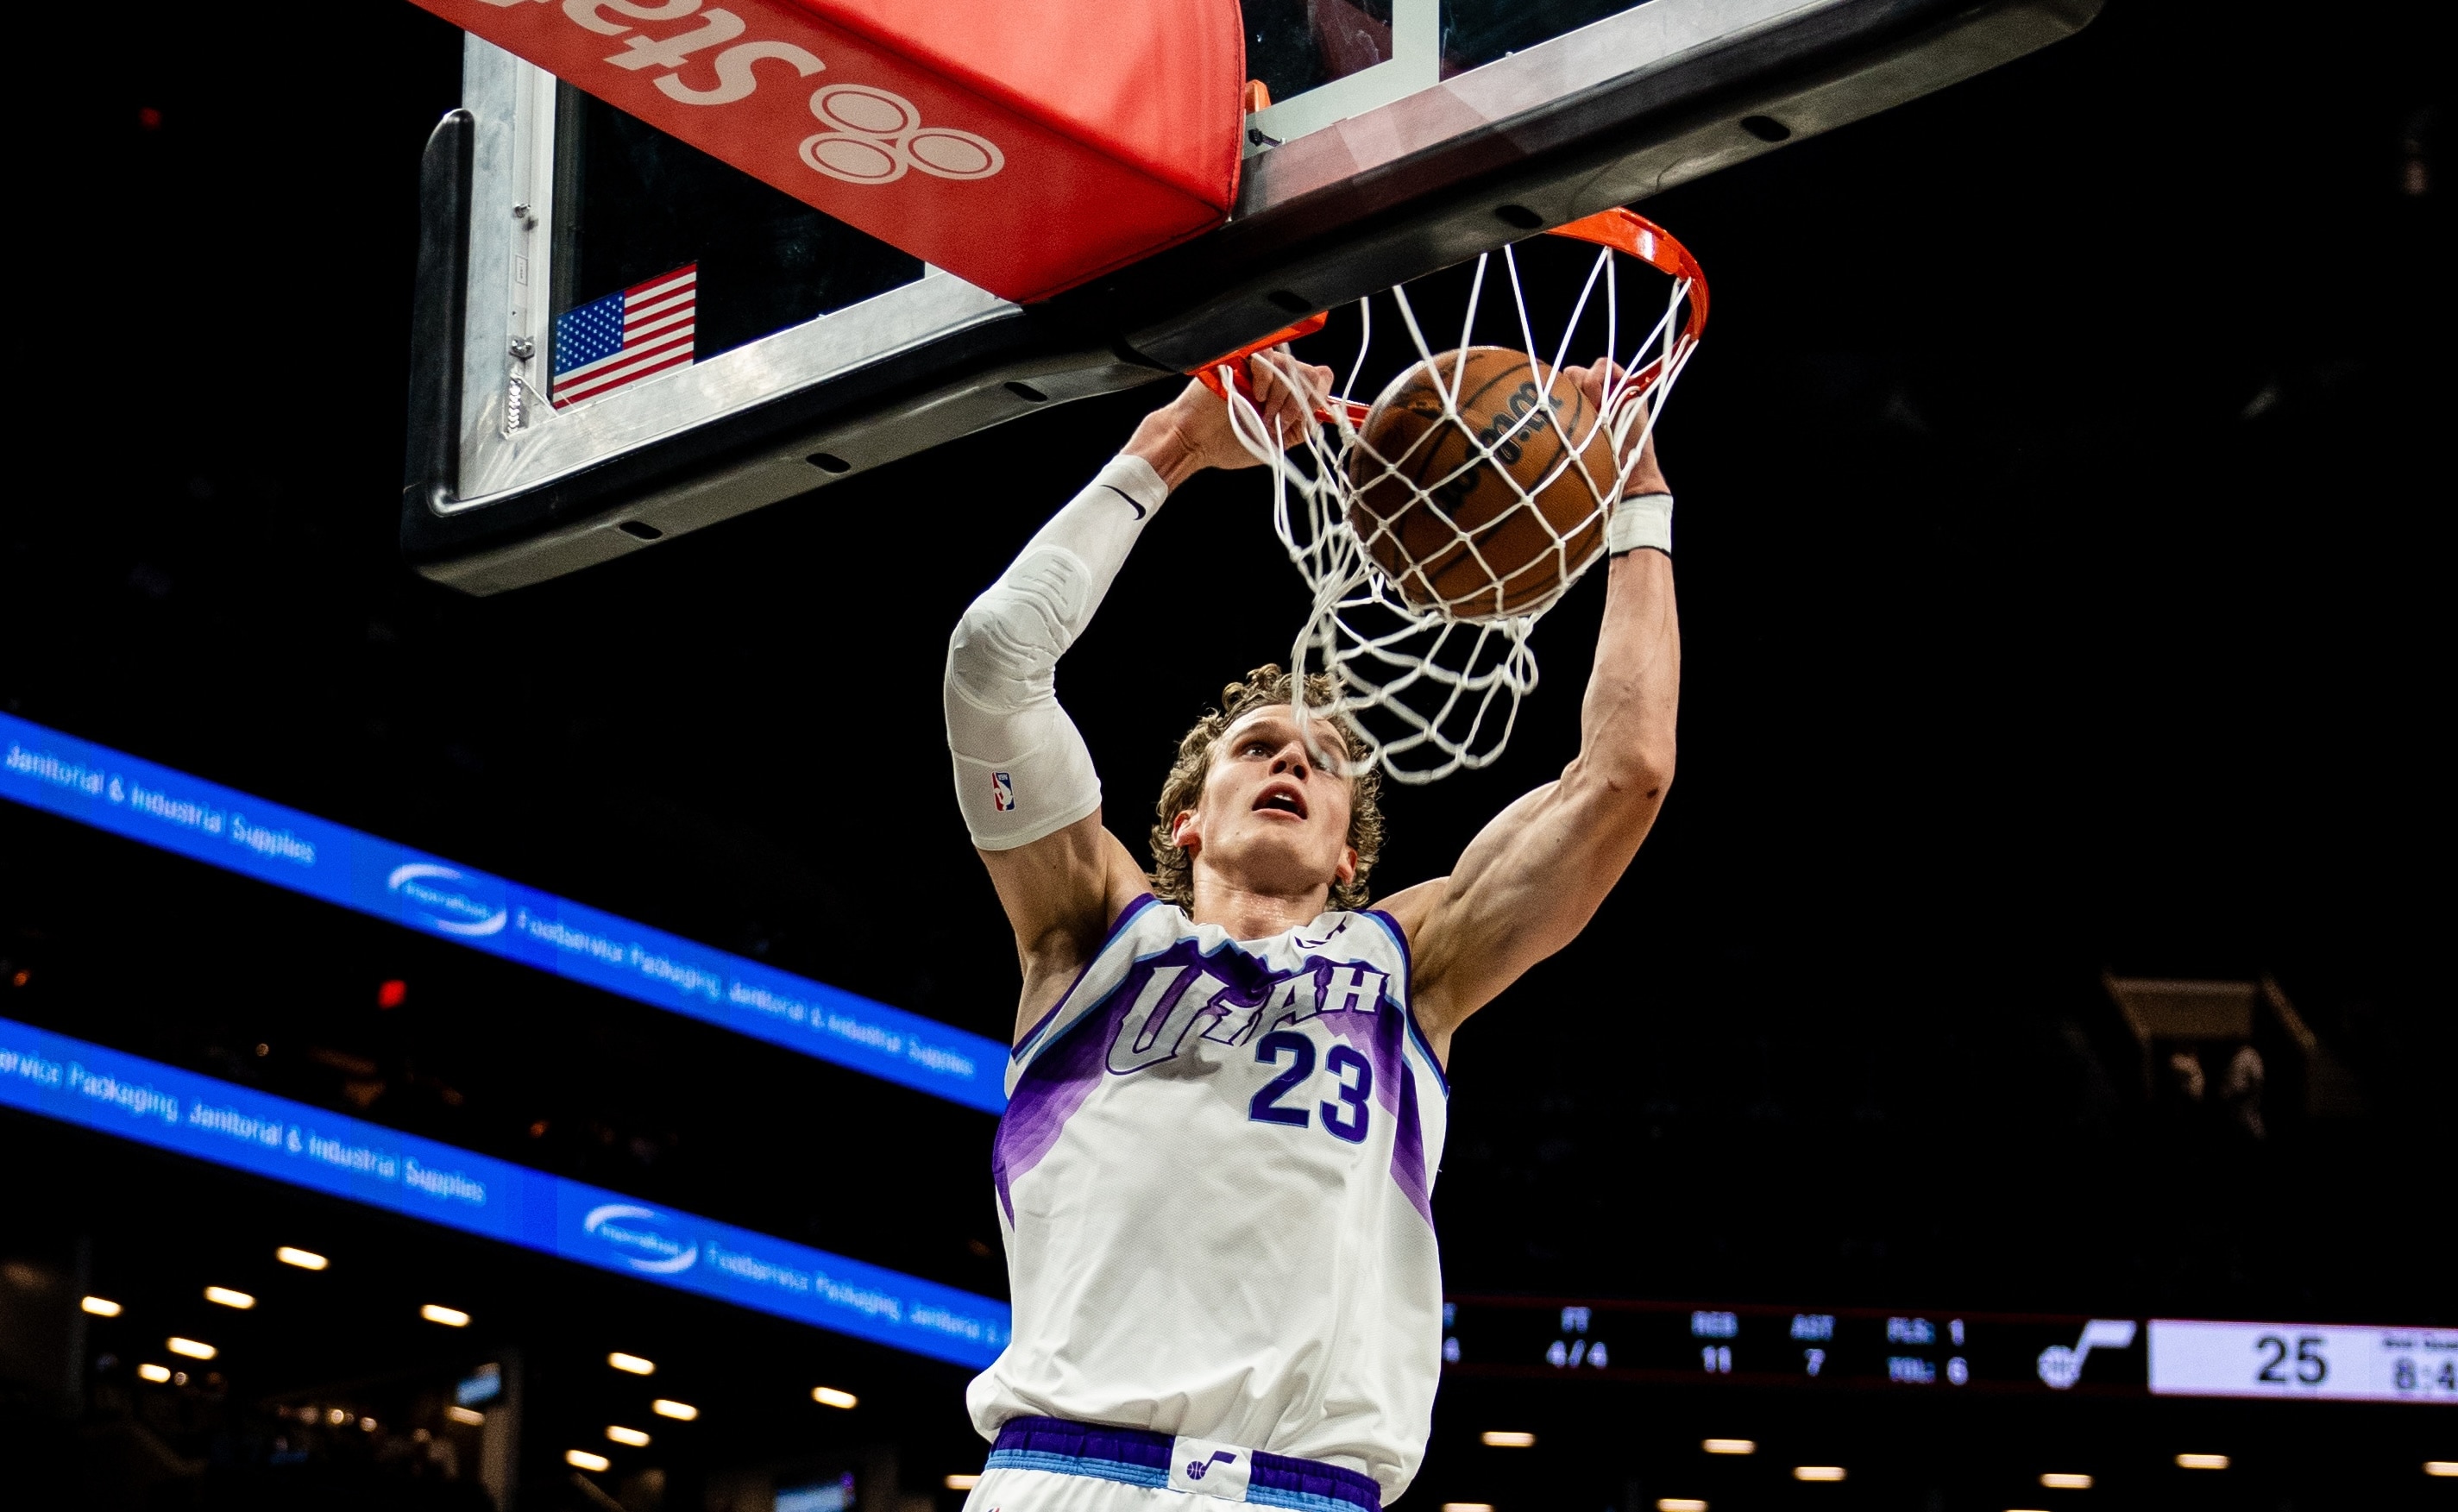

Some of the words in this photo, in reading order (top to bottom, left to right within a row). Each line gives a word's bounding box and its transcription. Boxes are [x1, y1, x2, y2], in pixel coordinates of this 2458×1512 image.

[5, 745, 104, 795] Janitorial
[108, 775, 125, 803] &
[130, 783, 226, 835] Industrial
[231, 814, 315, 864] Supplies
[1105, 964, 1390, 1076] UTAH
[1248, 1030, 1373, 1144] 23
[188, 1099, 283, 1148] Janitorial
[286, 1126, 303, 1153] &
[308, 1132, 400, 1182] Industrial
[405, 1157, 486, 1204] Supplies
[1545, 1339, 1608, 1369] 4/4
[1701, 1345, 1732, 1374] 11
[1804, 1348, 1826, 1377] 7
[1947, 1318, 1965, 1346] 1
[2257, 1336, 2327, 1386] 25
